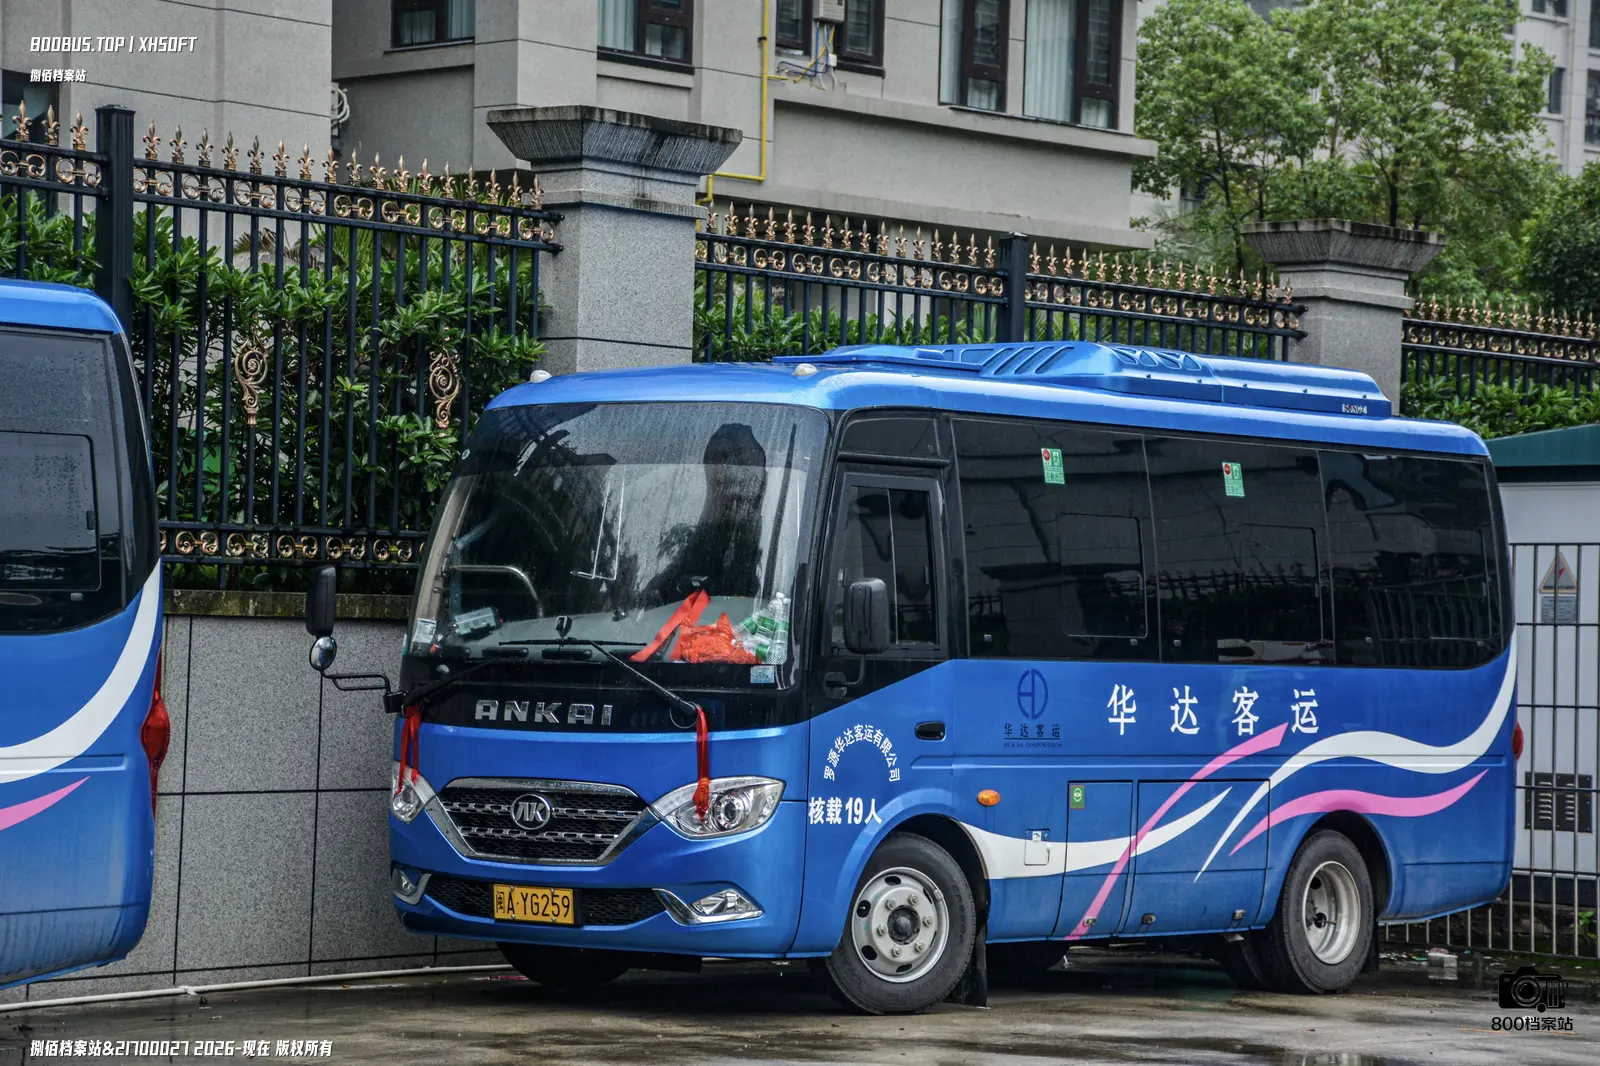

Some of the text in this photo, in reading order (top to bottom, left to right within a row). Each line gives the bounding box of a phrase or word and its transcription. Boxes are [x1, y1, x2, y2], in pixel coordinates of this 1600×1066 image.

[474, 699, 613, 726] ANKAI
[1106, 683, 1320, 736] 华达客运
[1003, 722, 1061, 738] 华达客运
[823, 723, 901, 782] 罗源华达客运有限公司
